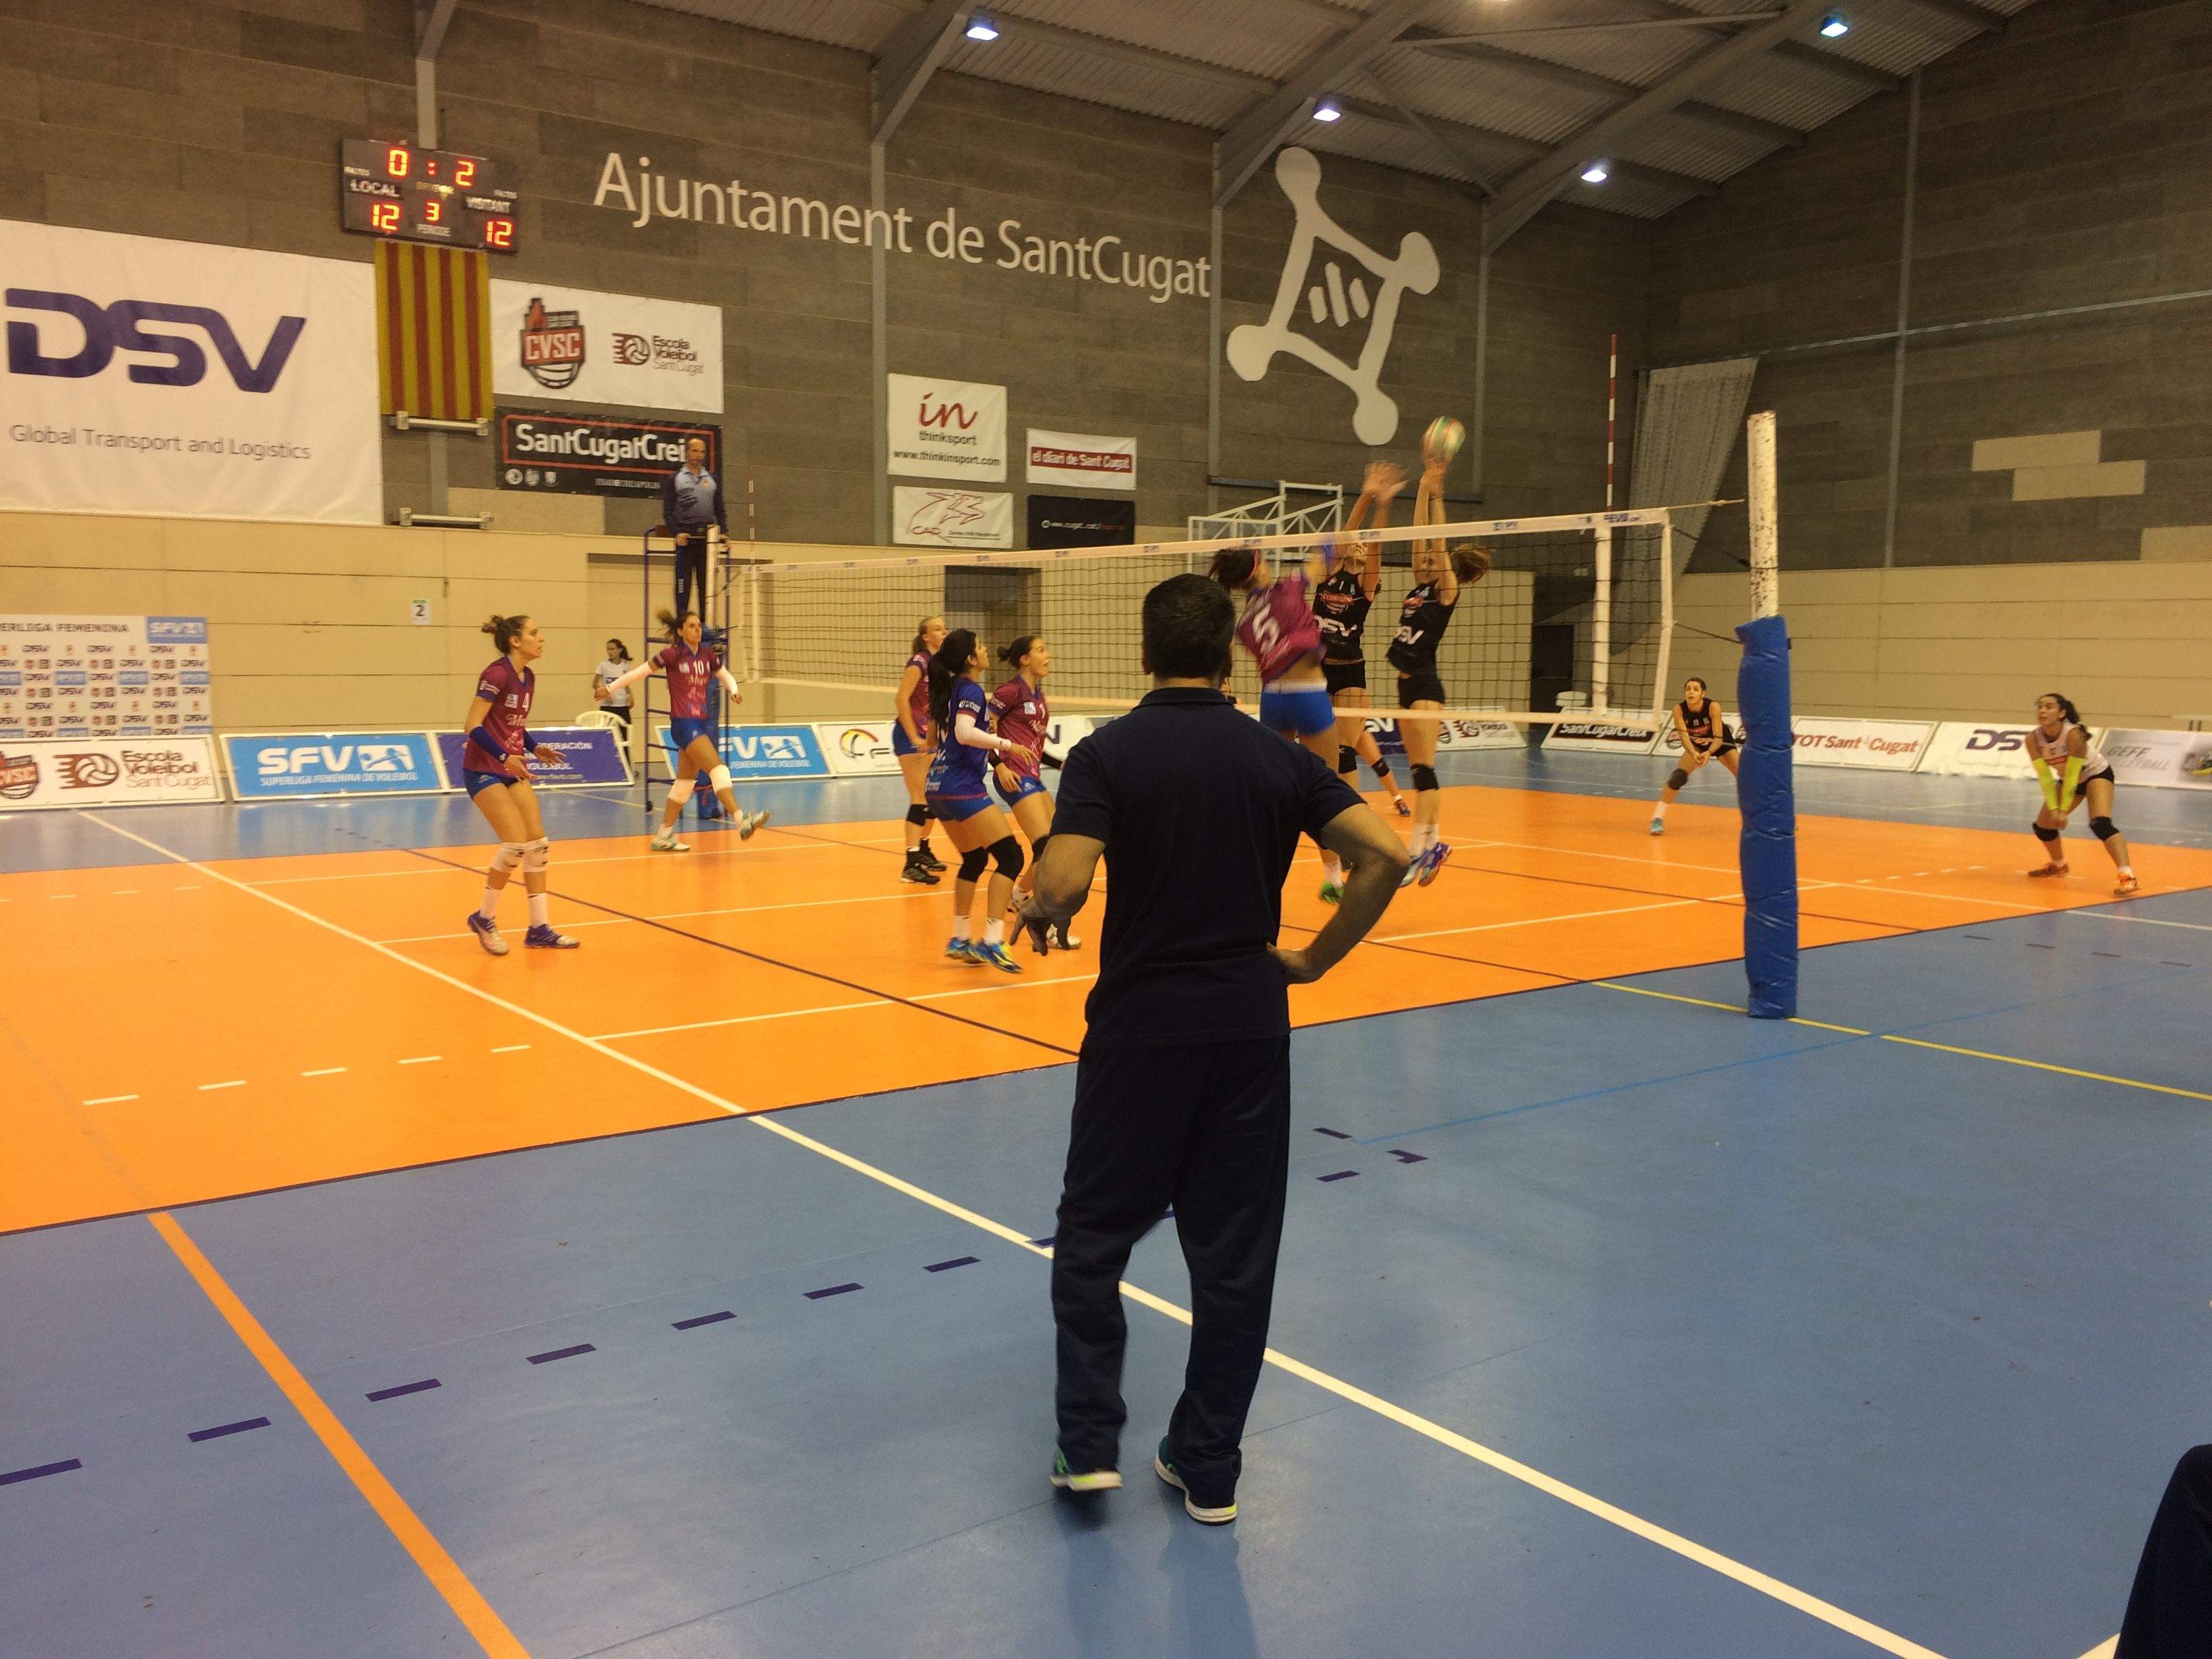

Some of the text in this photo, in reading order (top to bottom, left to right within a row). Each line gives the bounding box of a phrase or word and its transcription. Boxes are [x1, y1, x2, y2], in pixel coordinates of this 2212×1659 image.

[388, 149, 474, 186] 0 2
[350, 179, 400, 197] LOCAL
[373, 203, 400, 231] 12
[426, 203, 440, 221] 3
[594, 152, 913, 253] Ajuntament
[926, 207, 985, 264] de
[485, 221, 512, 246] 12
[5, 287, 306, 394] DSV
[525, 331, 581, 361] CVSC
[653, 335, 690, 350] Escola
[919, 392, 978, 430] in
[9, 424, 312, 462] Global Transport and Logistics
[515, 423, 687, 464] SantCugatCrei
[1031, 450, 1130, 470] el diari de Sant Cugat
[415, 604, 425, 617] 2
[693, 660, 704, 676] 10
[522, 693, 530, 712] 4
[1825, 736, 1863, 749] Sant
[1868, 737, 1919, 755] Cugat
[1965, 729, 2030, 751] DS
[122, 750, 182, 762] Escola
[257, 745, 354, 775] SFV
[124, 761, 199, 775] Voleibol
[125, 774, 211, 790] Sant Cugat
[260, 776, 312, 786] SUPERLIGA
[314, 774, 361, 783] FEMENINA
[375, 772, 419, 781] VOLEIBOL
